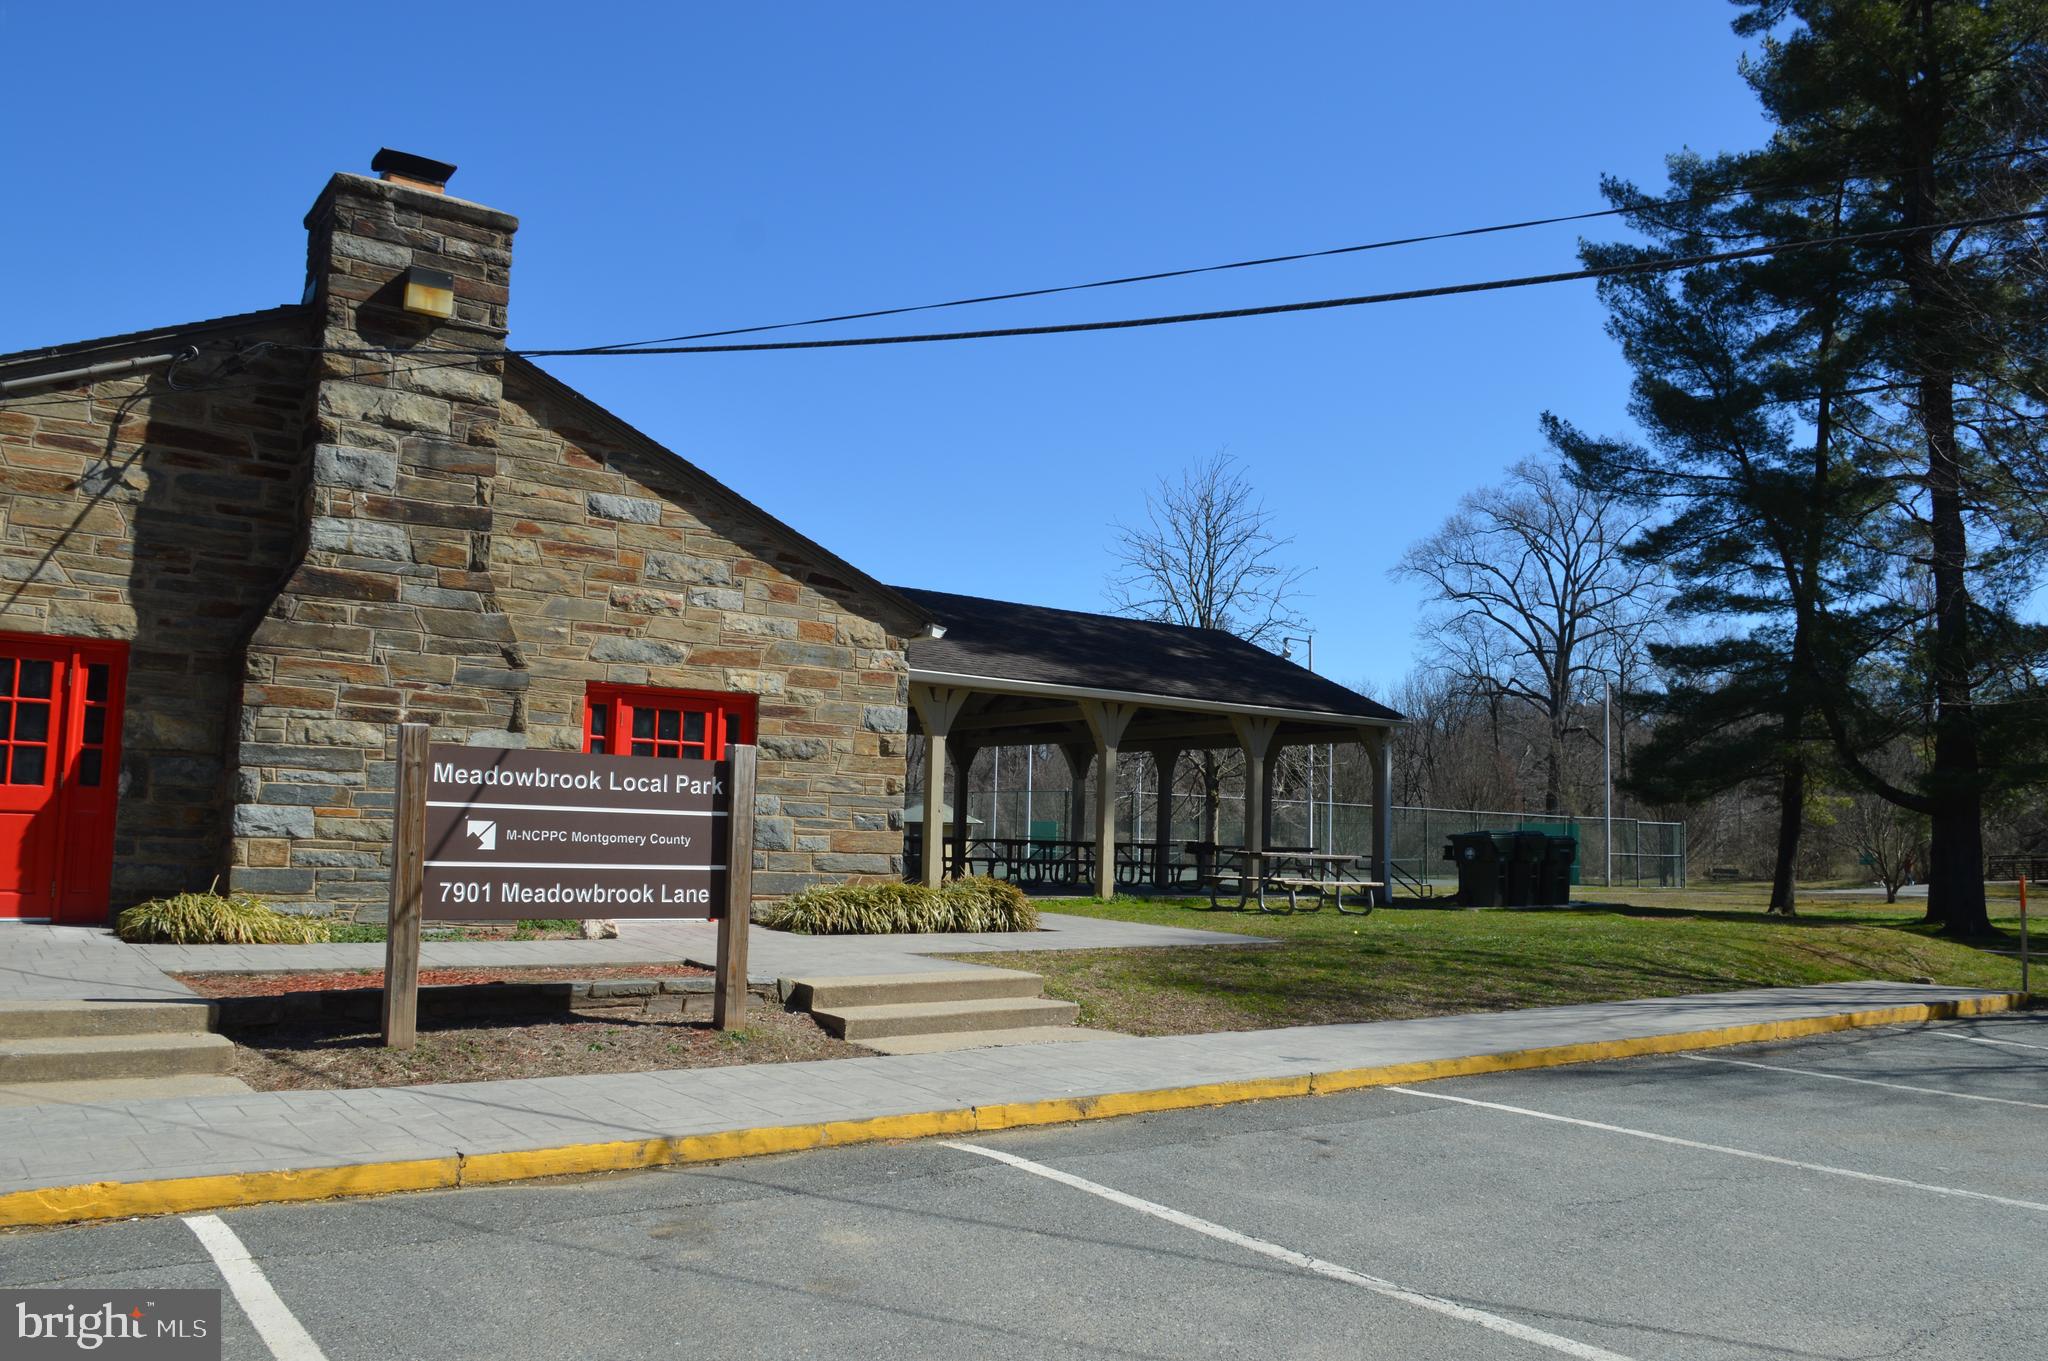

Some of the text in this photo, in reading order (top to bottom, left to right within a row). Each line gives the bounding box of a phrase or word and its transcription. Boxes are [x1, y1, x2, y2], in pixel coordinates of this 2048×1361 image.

[433, 762, 724, 795] Meadowbrook Local Park
[506, 829, 691, 848] M-NCPPC Montgomery County
[439, 881, 710, 903] 7901 Meadowbrook Lane
